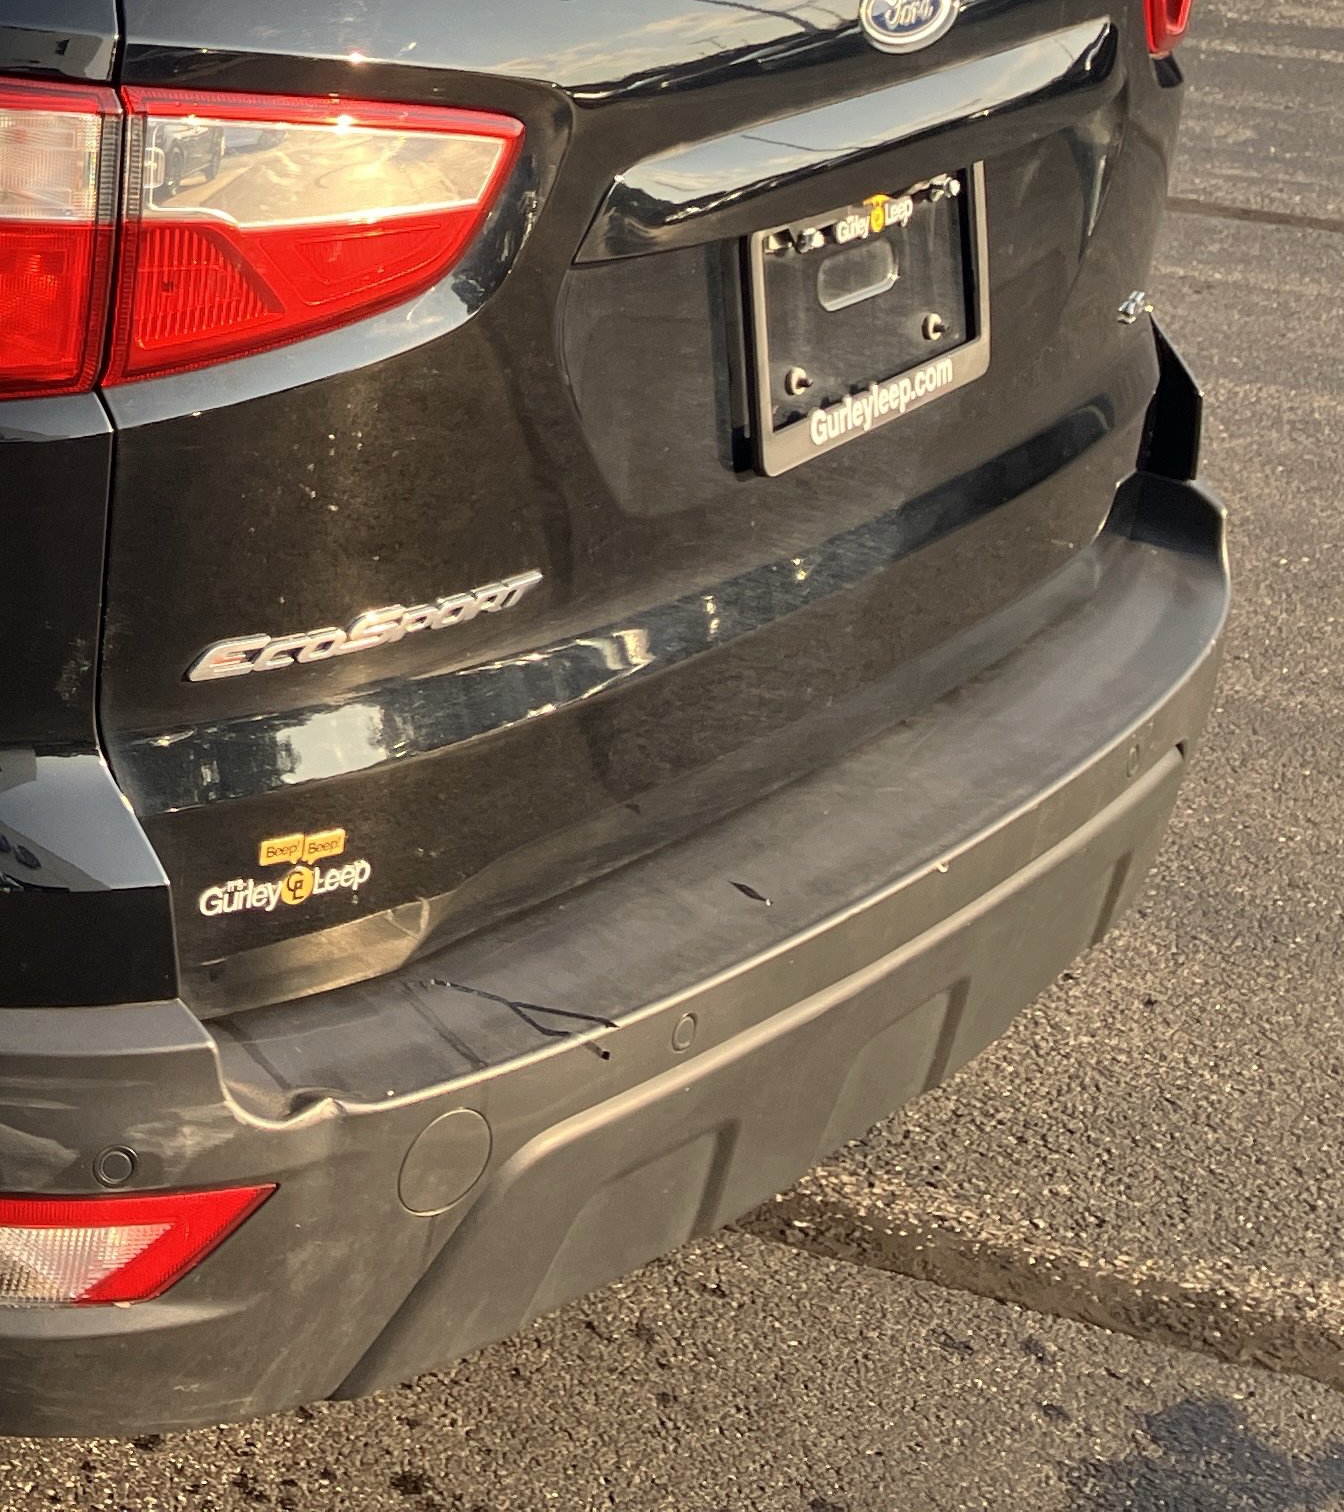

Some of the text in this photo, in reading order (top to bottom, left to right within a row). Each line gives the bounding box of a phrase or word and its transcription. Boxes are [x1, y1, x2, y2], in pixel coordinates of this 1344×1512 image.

[885, 197, 913, 227] Leep
[810, 358, 953, 446] Gurleyleep.com
[266, 840, 301, 858] Beep!
[198, 878, 283, 917] Gurley
[313, 859, 371, 895] Leep
